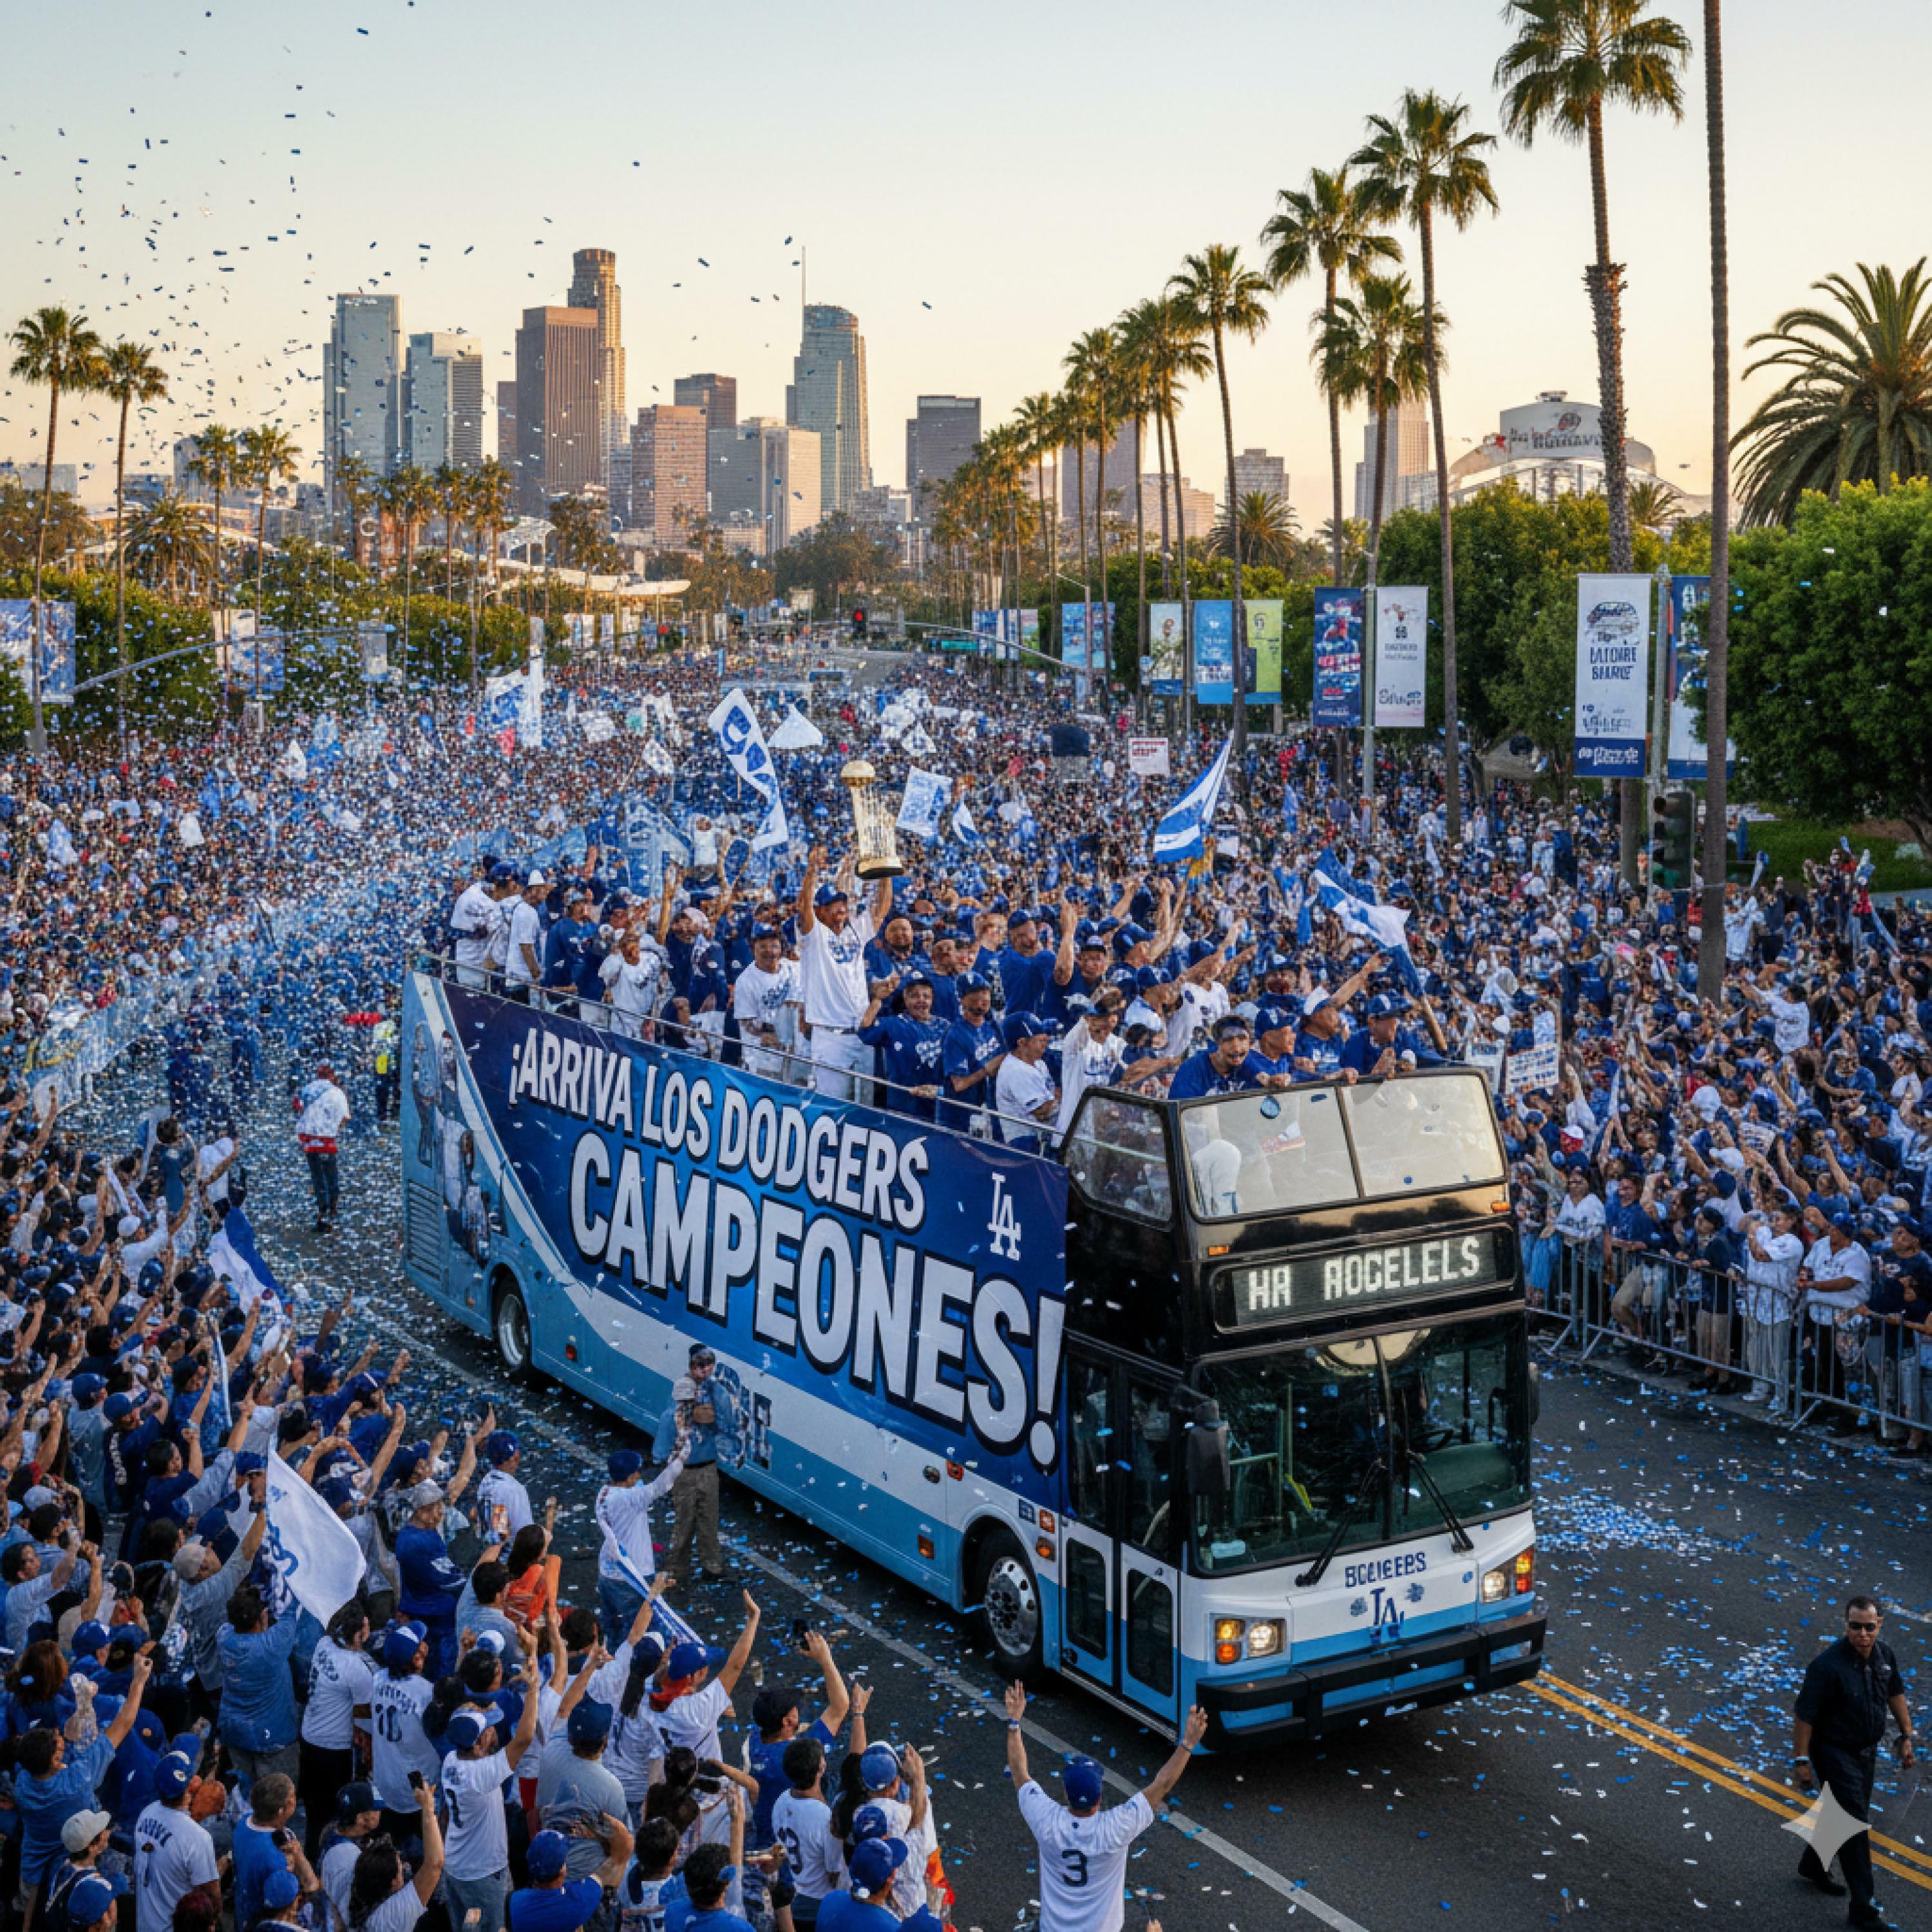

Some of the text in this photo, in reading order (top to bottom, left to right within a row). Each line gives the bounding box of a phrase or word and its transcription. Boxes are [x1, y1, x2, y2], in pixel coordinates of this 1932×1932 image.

[509, 1028, 929, 1229] ¡ARRIVA LOS DODGERS
[987, 1172, 1021, 1261] LA
[571, 1132, 1066, 1465] CAMPEONES!
[1062, 1849, 1088, 1887] 3
